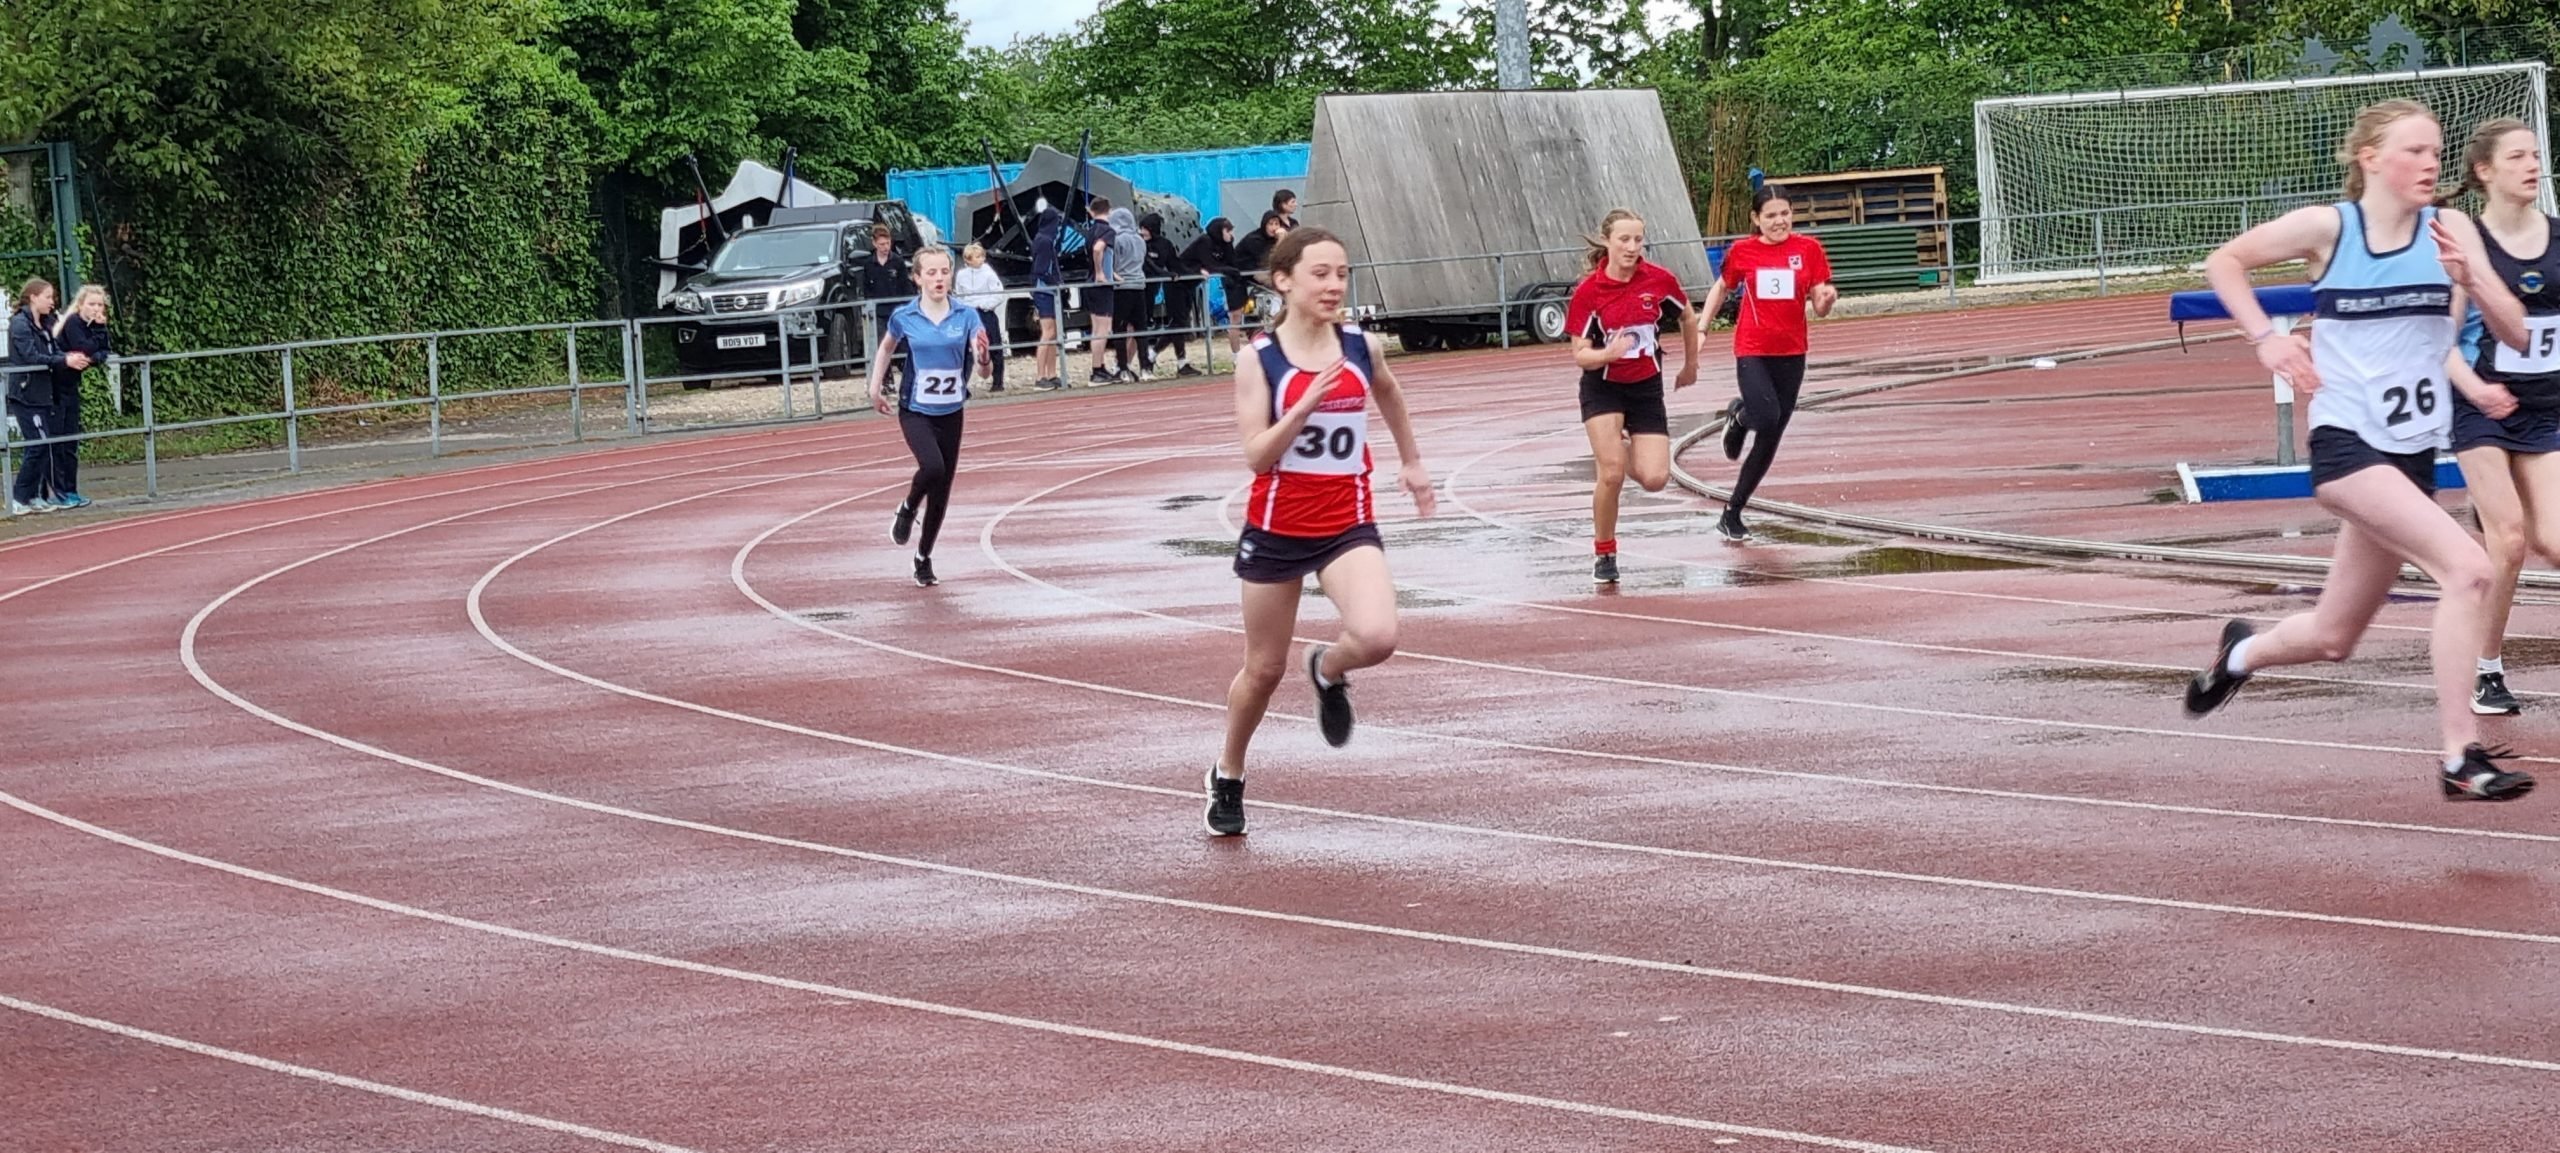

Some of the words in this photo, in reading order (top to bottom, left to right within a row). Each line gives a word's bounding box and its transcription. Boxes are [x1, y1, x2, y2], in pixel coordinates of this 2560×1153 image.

[1770, 278, 1781, 295] 3
[924, 376, 957, 395] 22
[2383, 377, 2435, 427] 26
[1294, 425, 1355, 460] 30
